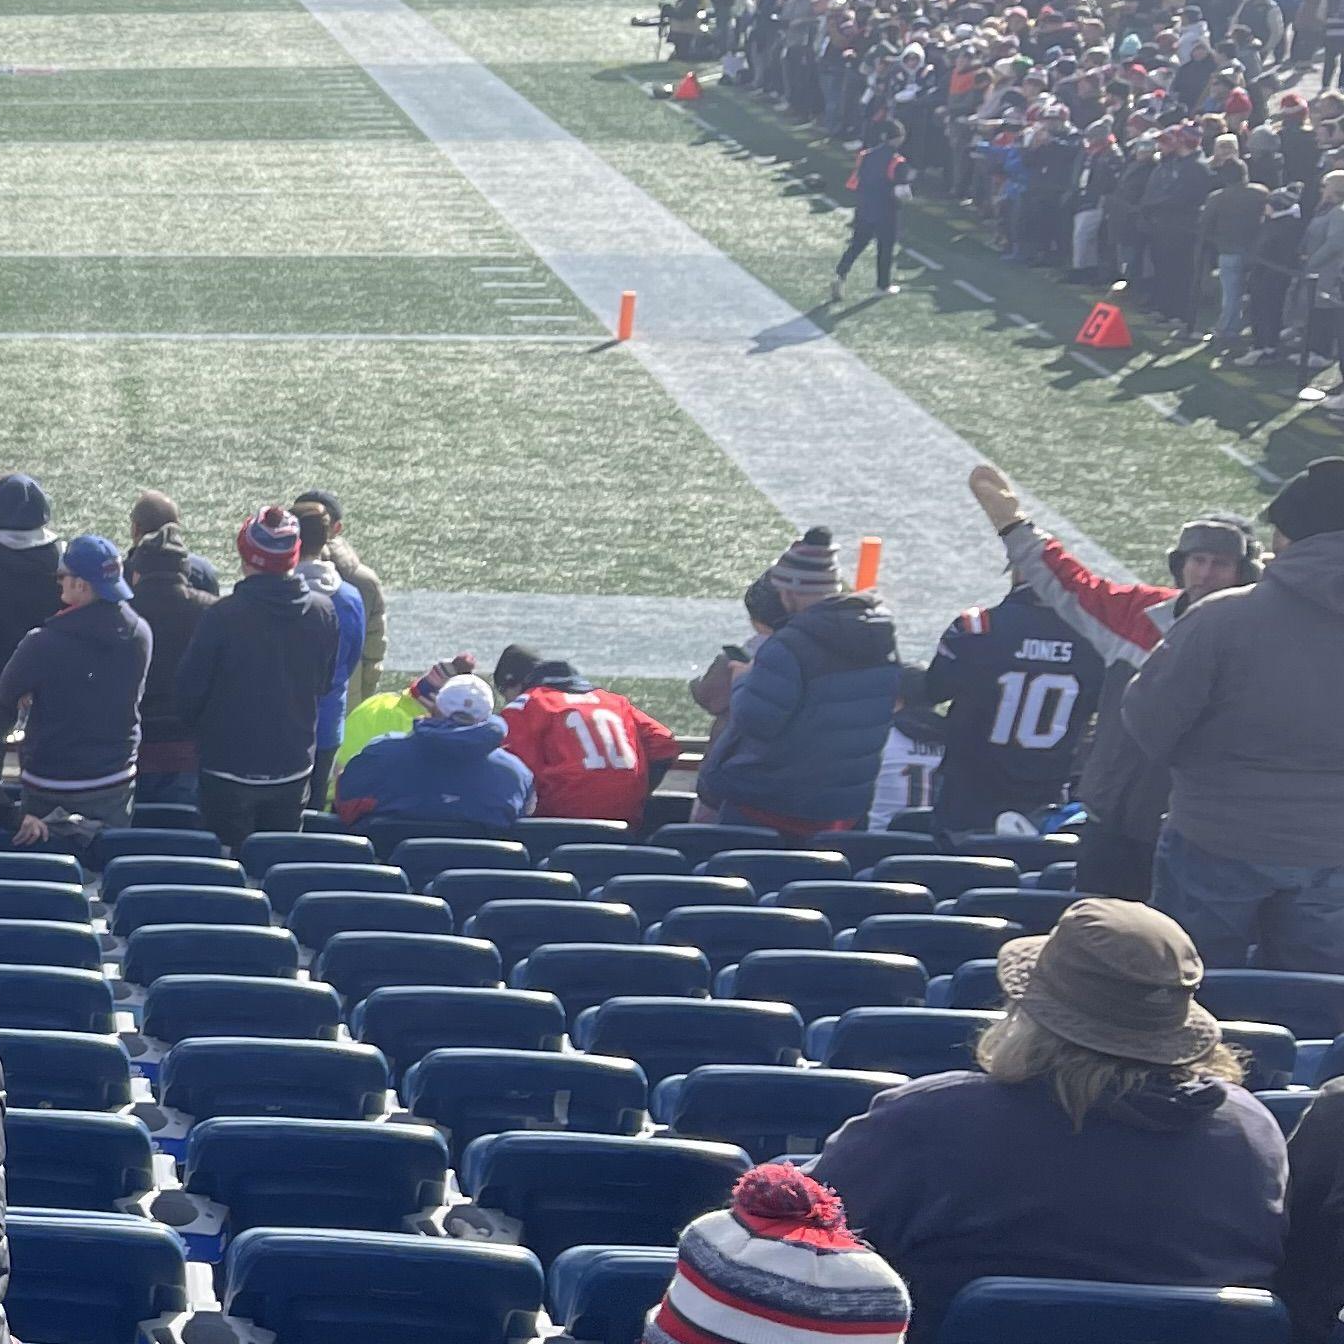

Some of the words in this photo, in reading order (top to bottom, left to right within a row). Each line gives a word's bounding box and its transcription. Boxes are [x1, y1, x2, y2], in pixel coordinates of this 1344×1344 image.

[1015, 638, 1073, 664] JONES
[565, 708, 636, 771] 10
[988, 671, 1081, 750] 10
